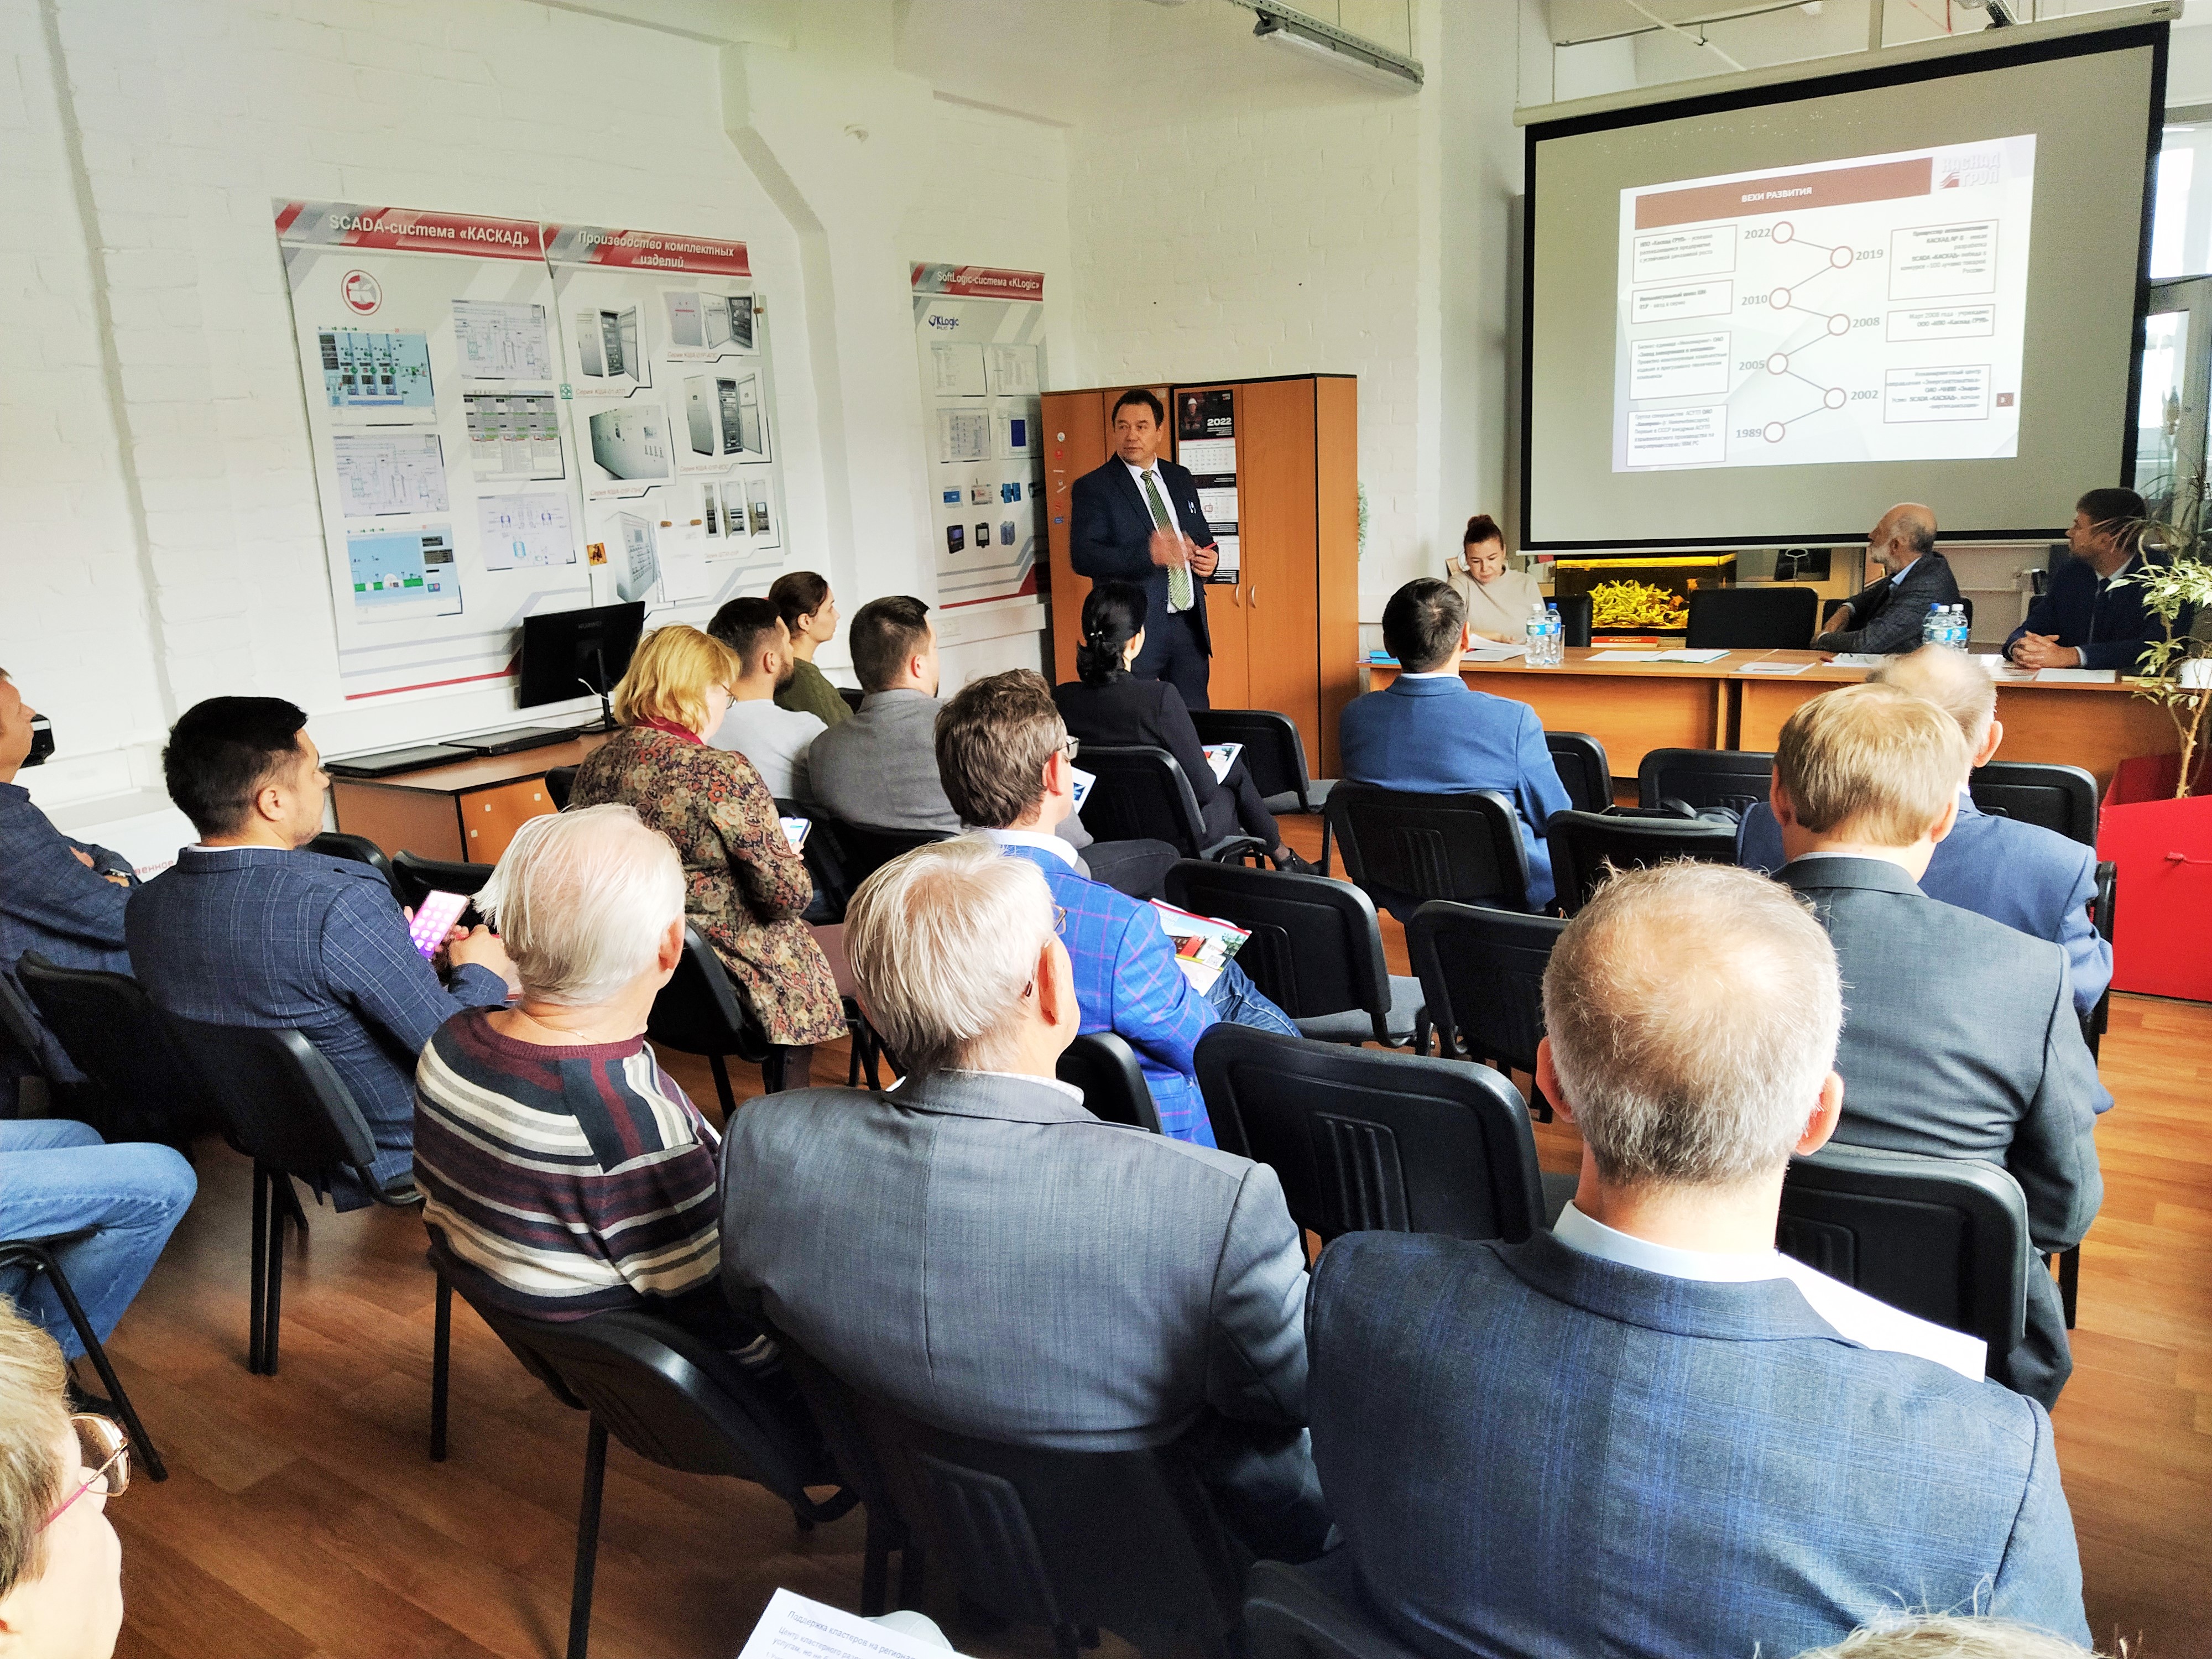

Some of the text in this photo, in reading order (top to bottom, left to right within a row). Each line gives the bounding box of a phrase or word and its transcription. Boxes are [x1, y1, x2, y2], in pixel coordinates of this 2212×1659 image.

[1741, 186, 1813, 203] ВЕХИ РАЗВИТИЯ
[329, 214, 530, 248] SCADA-система «КАСКАД»
[1744, 228, 1771, 240] 2022
[578, 231, 734, 257] Производство комплектных
[640, 253, 685, 268] изделий
[1855, 249, 1884, 260] 2019
[937, 271, 1040, 291] SoftLogic-система «KLogic»
[1741, 294, 1768, 305] 2010
[1852, 316, 1880, 328] 2008
[1739, 359, 1766, 371] 2005
[1850, 390, 1879, 401] 2002
[1207, 417, 1233, 426] 2022
[1735, 427, 1762, 439] 1989
[787, 1610, 828, 1632] Поддержка
[828, 1627, 868, 1646] кластеров
[779, 1626, 800, 1640] Центр
[800, 1636, 842, 1656] кластерного
